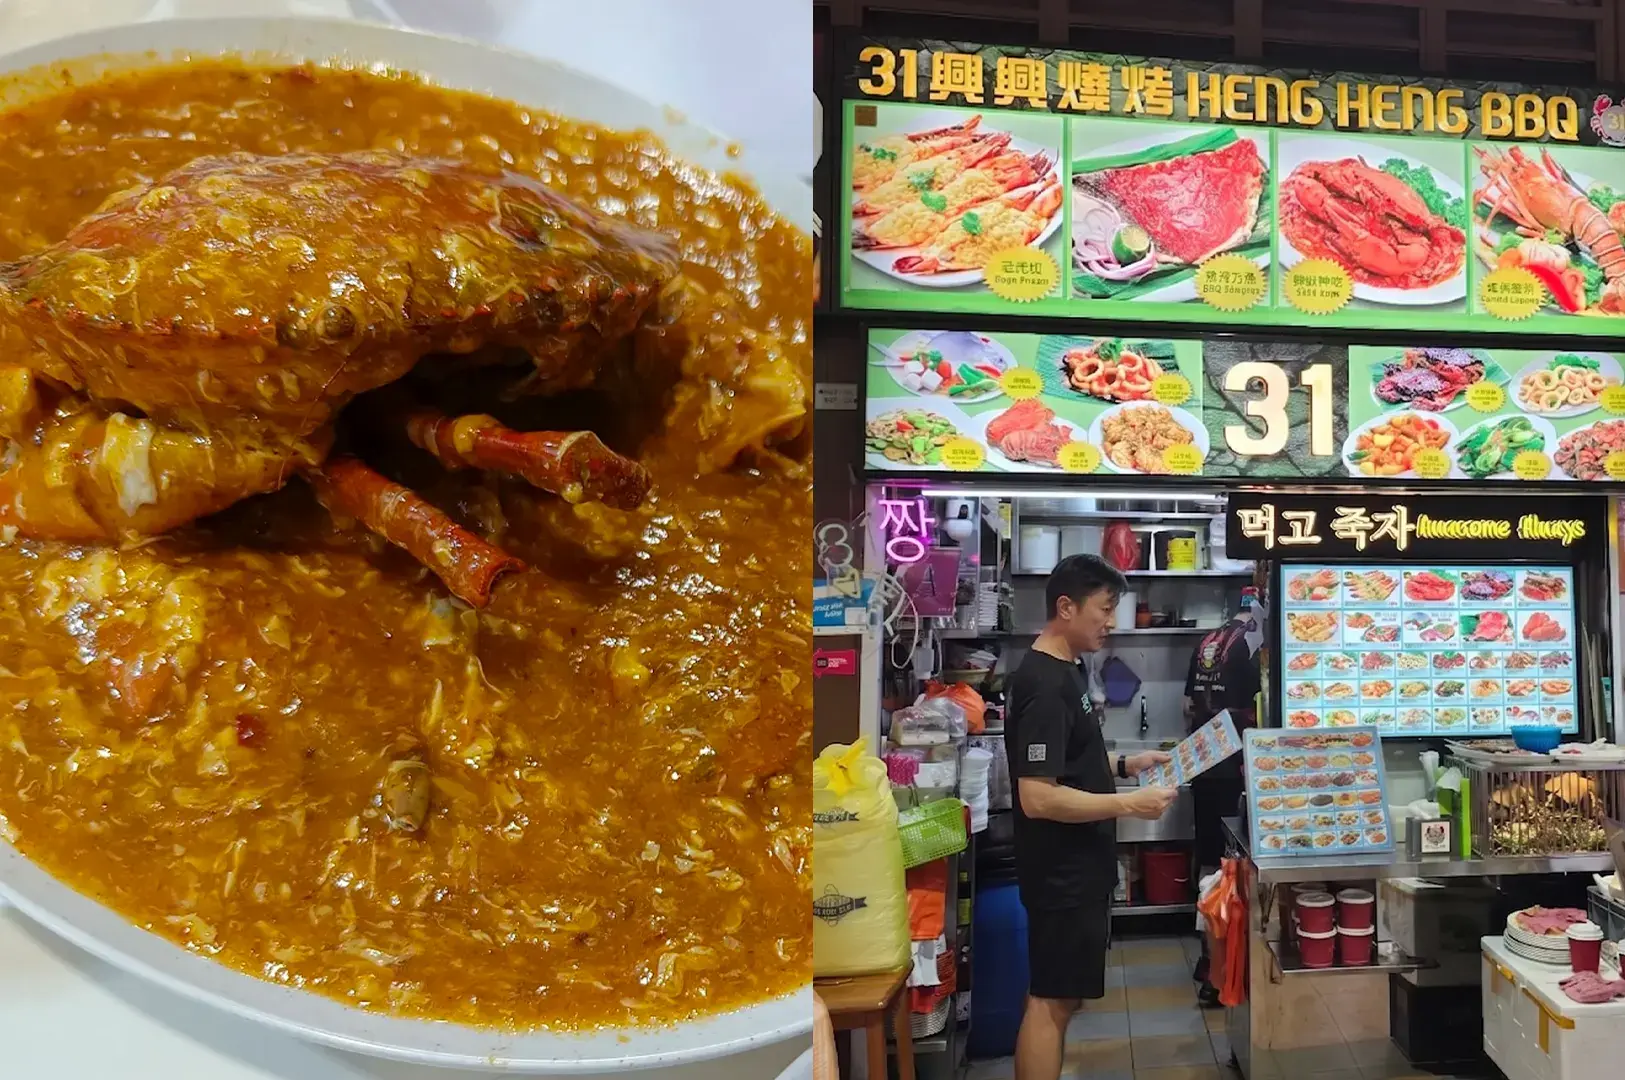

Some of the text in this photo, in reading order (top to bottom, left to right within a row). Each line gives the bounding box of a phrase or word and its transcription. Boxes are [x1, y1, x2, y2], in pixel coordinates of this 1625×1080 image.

[858, 46, 918, 99] 31
[1186, 71, 1324, 126] HENG
[1336, 81, 1471, 135] HENG
[1480, 91, 1581, 142] BBQ
[1223, 361, 1333, 456] 31
[878, 499, 936, 562] 짱
[1236, 503, 1322, 551] 먹고
[1330, 504, 1416, 552] 죽자
